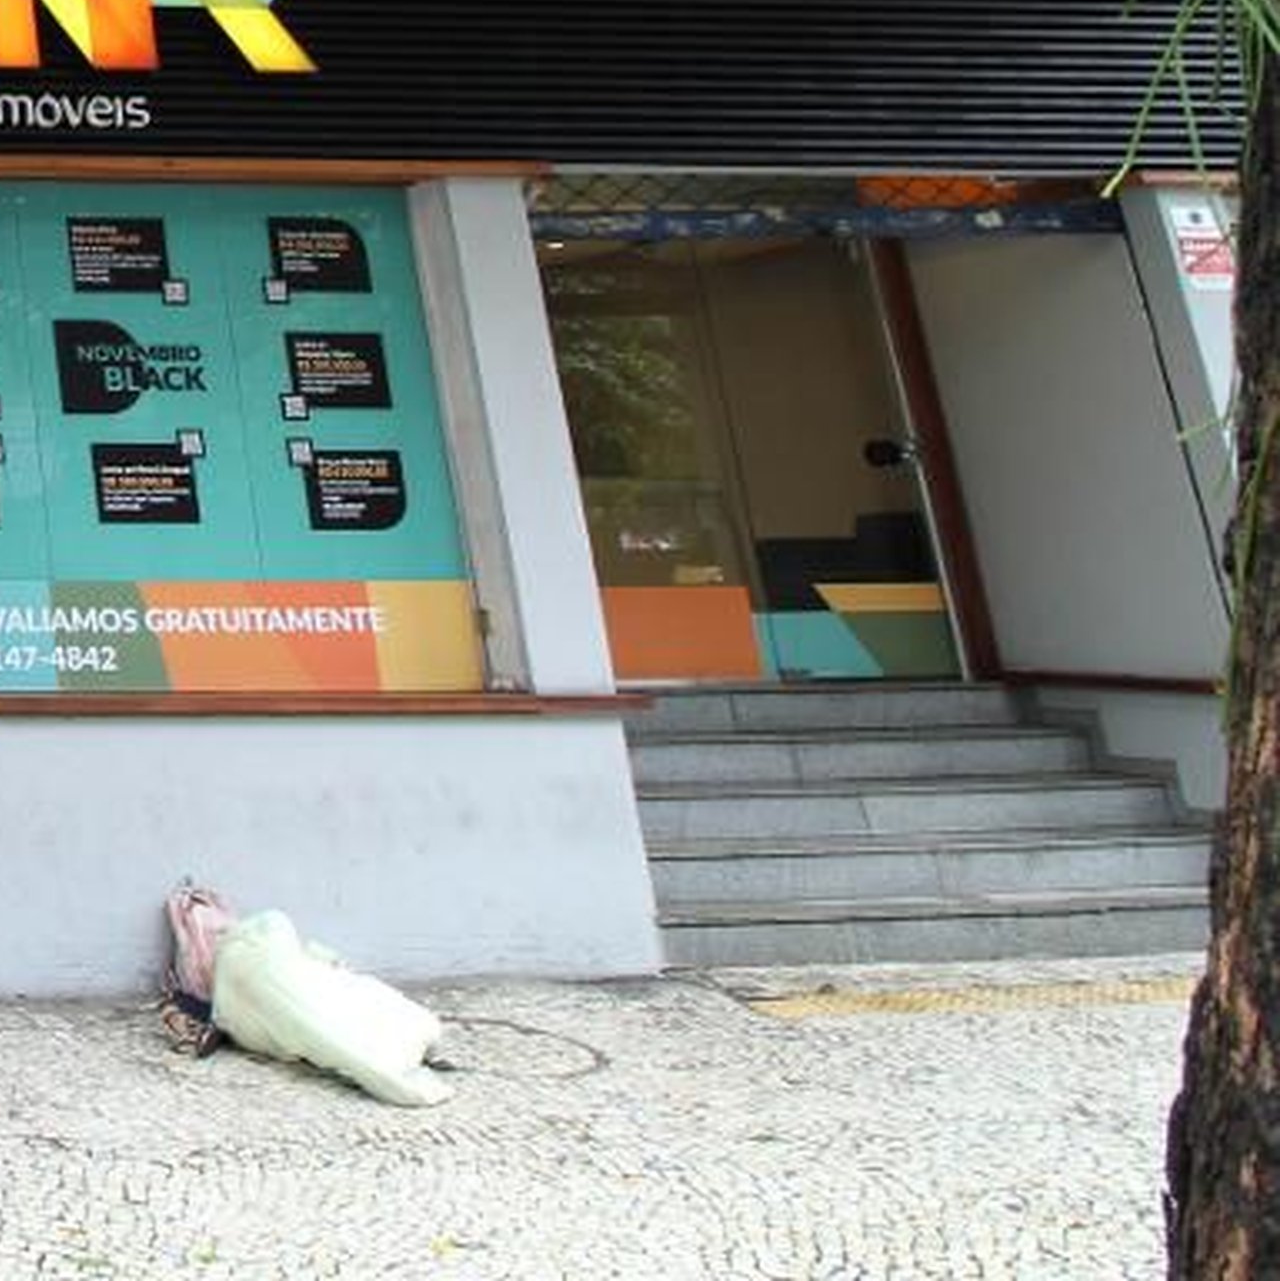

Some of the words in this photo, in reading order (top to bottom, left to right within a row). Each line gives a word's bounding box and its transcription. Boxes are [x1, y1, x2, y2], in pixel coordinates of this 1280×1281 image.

[76, 340, 202, 362] NOVEMBRO
[104, 366, 207, 392] BLACK
[144, 605, 388, 633] GRATUITAMENTE
